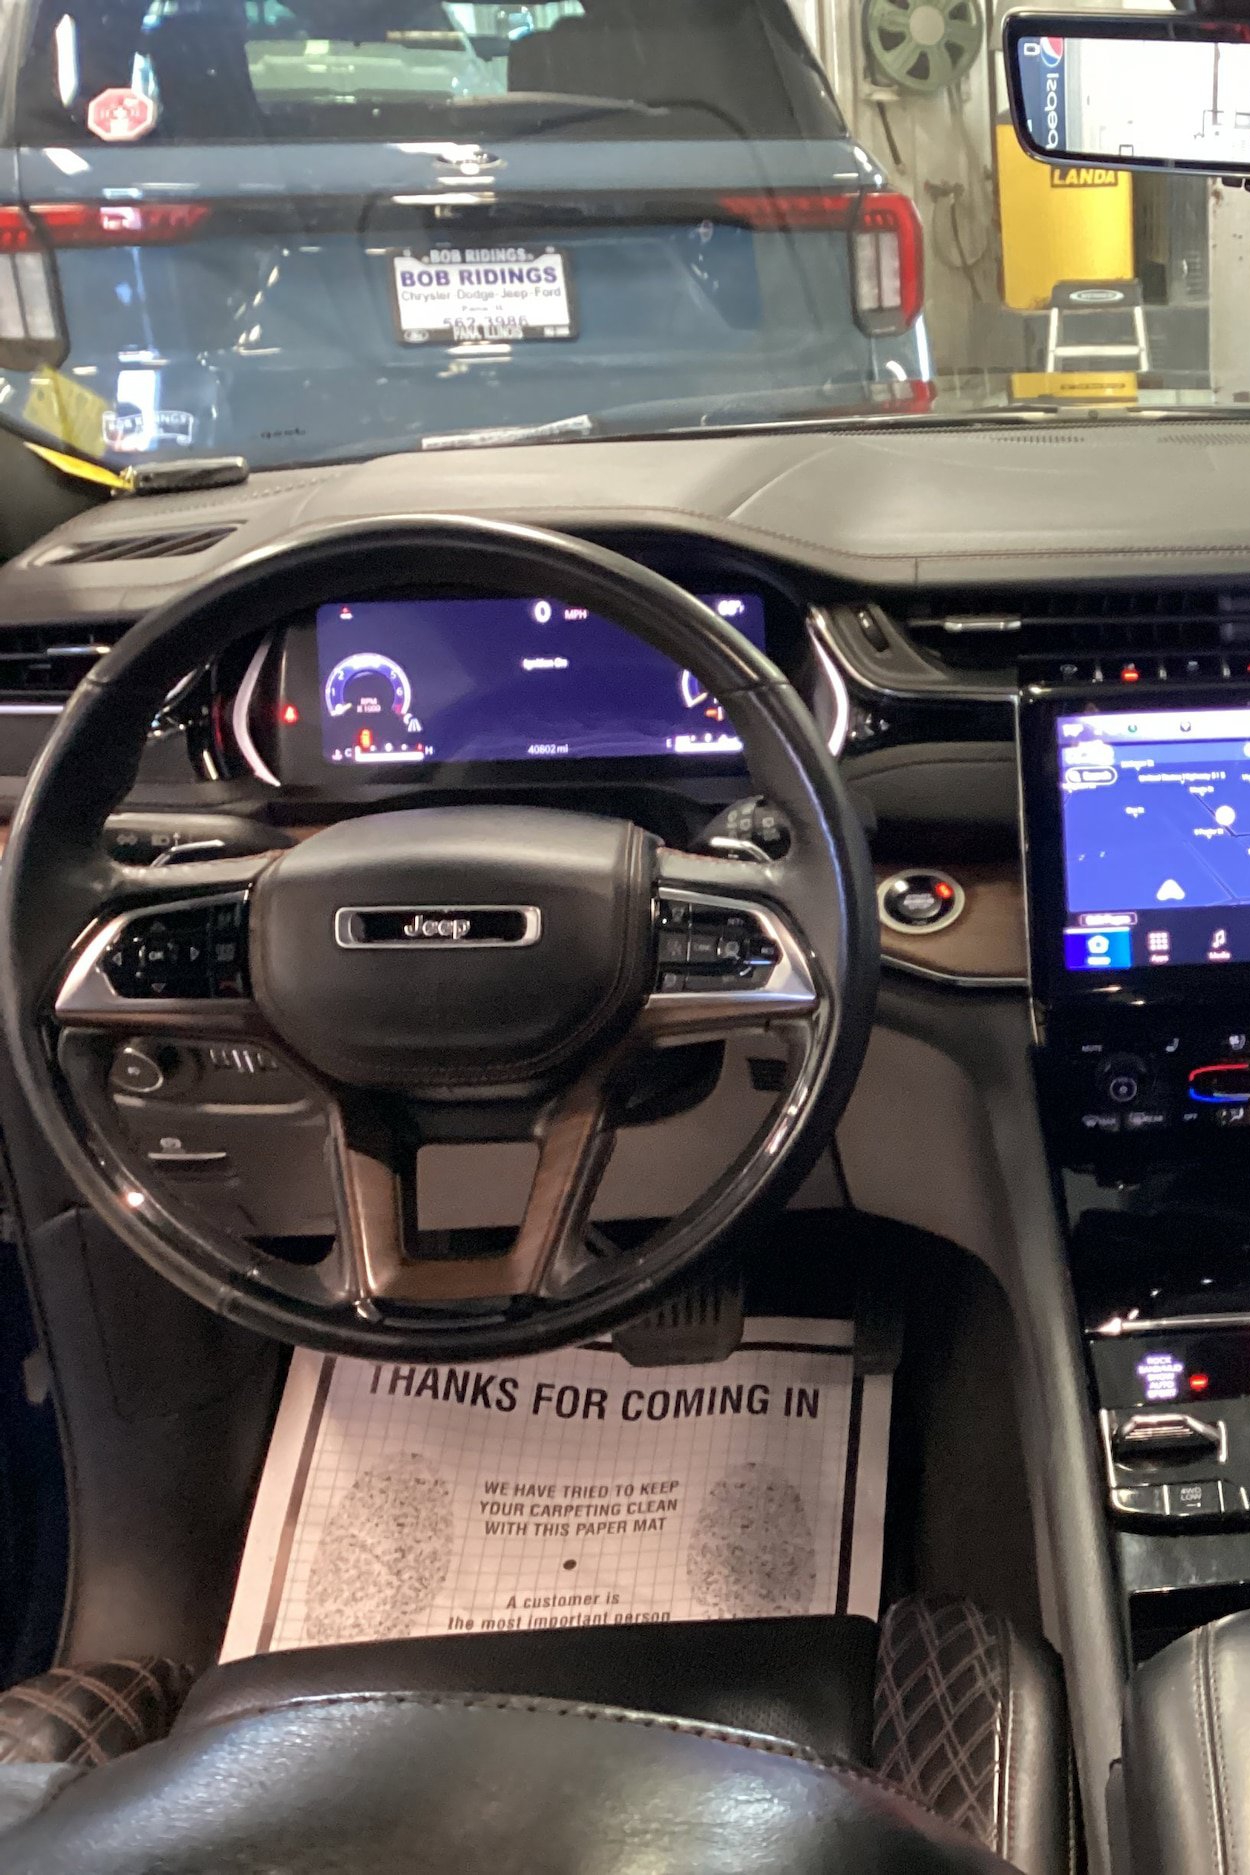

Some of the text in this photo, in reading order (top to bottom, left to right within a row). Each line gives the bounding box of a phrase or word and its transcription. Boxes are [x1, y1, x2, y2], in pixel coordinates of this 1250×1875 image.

[1053, 168, 1117, 185] LANDA
[429, 247, 526, 263] BOB RIDINGS
[400, 266, 558, 287] BOB RIDINGS
[535, 600, 587, 623] 0 MPH
[528, 745, 556, 754] 40802
[404, 914, 471, 939] Jeep
[532, 1382, 608, 1420] FOR
[622, 1384, 770, 1421] COMING
[784, 1387, 820, 1418] IN
[485, 1480, 679, 1499] WE HAVE TRIED TO KEEP
[480, 1499, 678, 1518] YOUR CARPETING CLEAN
[485, 1517, 667, 1537] WITH THIS PAPER MAT
[507, 1592, 620, 1609] A customer is
[448, 1616, 474, 1630] the
[481, 1615, 521, 1630] most
[528, 1611, 608, 1628] important
